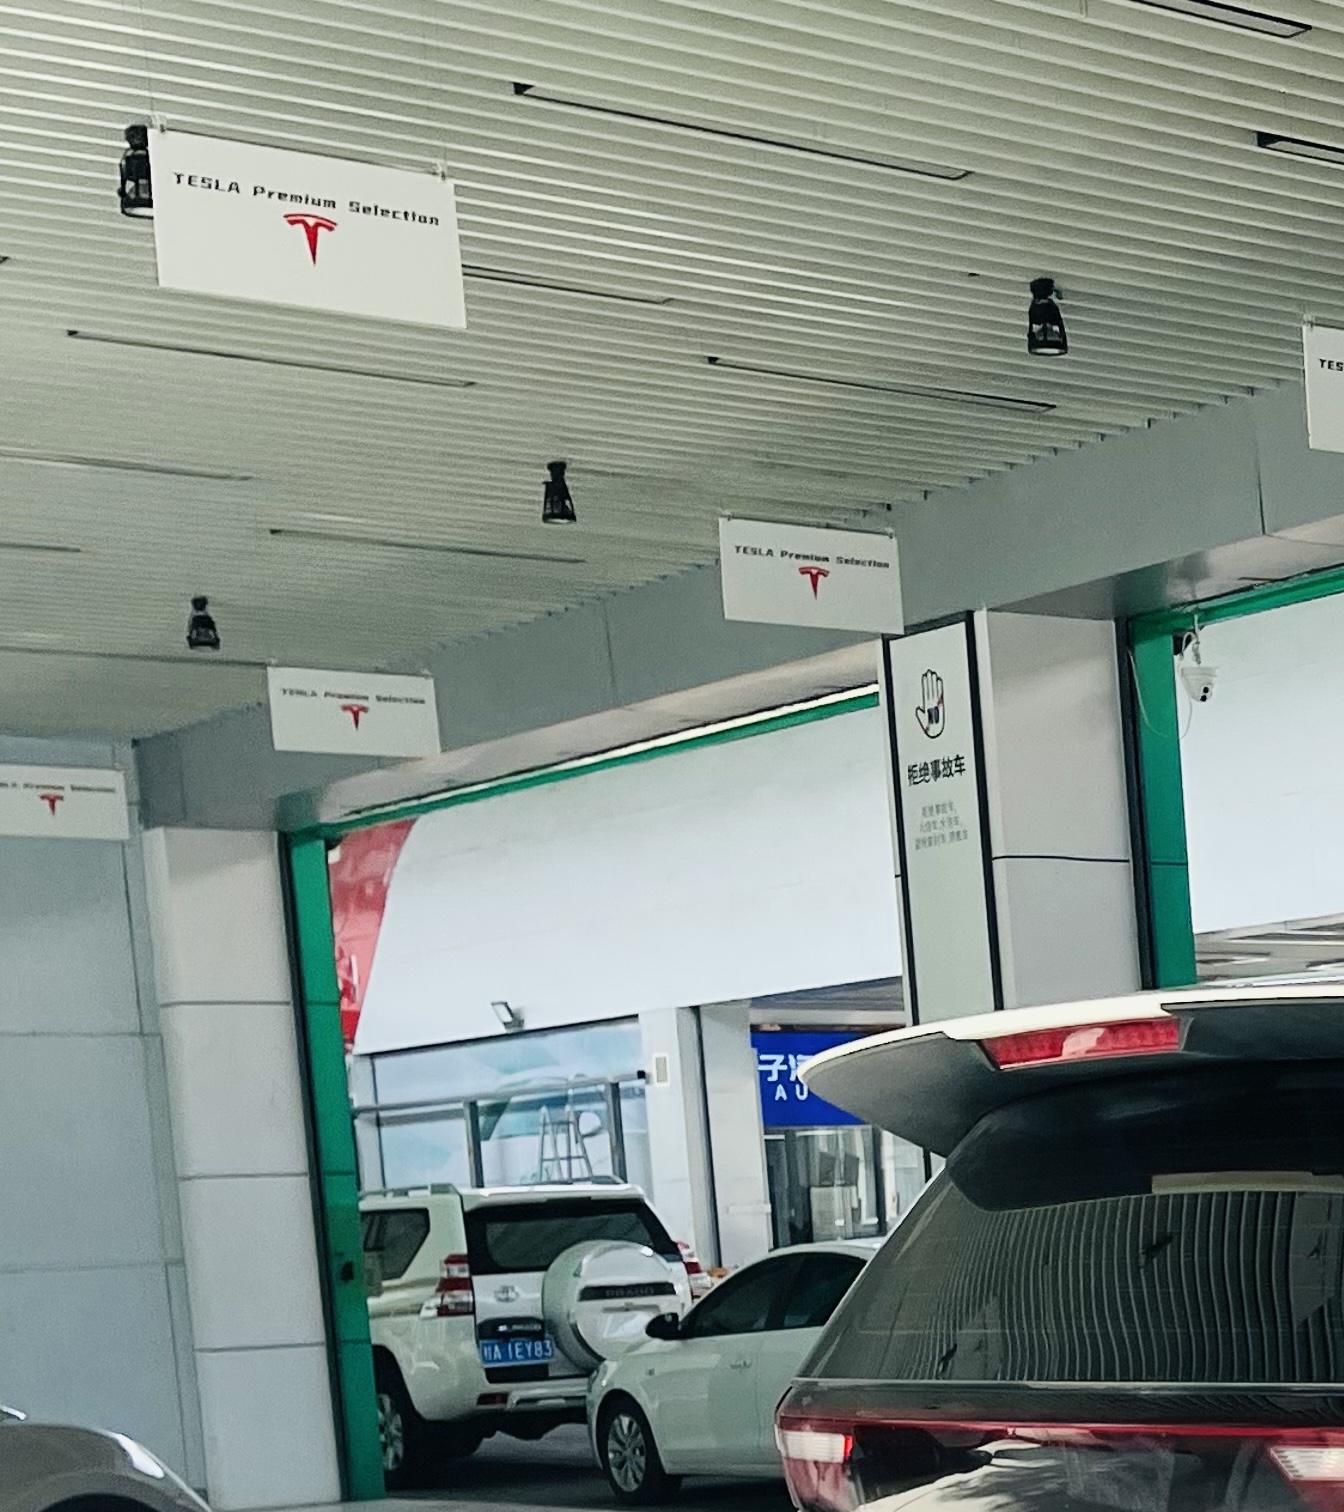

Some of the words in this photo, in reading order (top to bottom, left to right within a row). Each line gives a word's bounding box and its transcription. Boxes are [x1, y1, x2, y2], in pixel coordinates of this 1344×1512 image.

[172, 172, 241, 194] TESLA
[253, 185, 337, 209] Premium
[349, 201, 439, 226] Selection
[734, 545, 774, 558] TESLA
[780, 550, 830, 563] Premium
[836, 556, 890, 569] Selection
